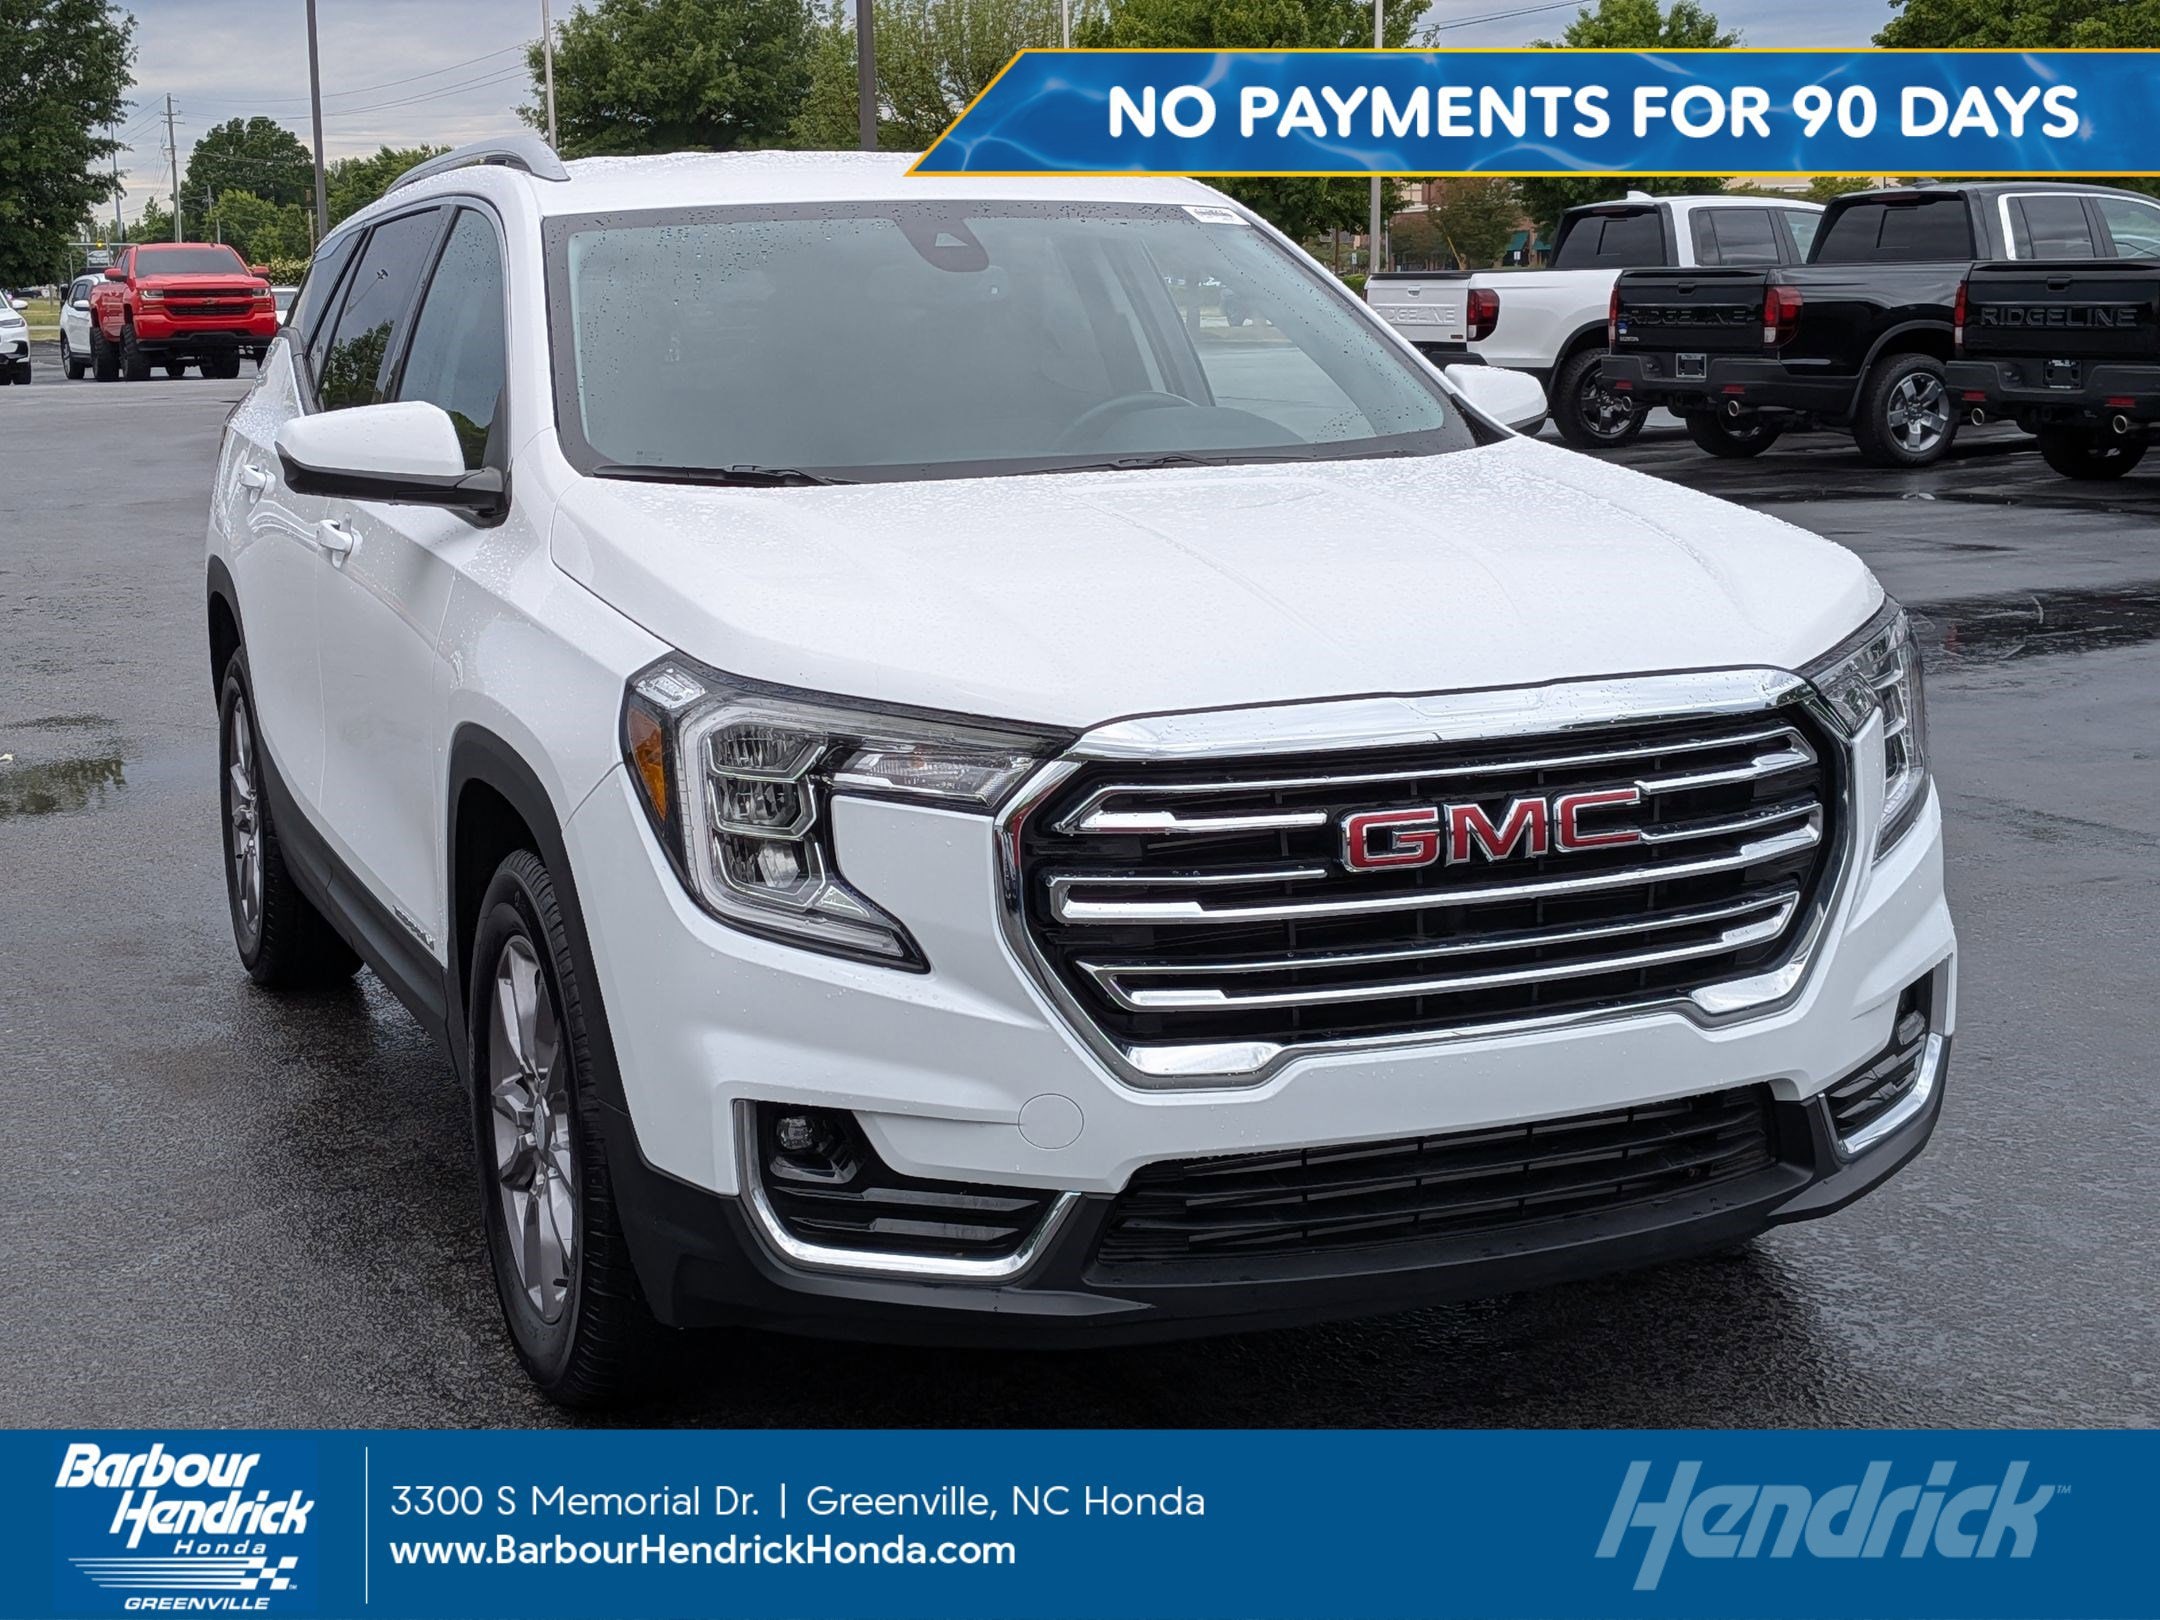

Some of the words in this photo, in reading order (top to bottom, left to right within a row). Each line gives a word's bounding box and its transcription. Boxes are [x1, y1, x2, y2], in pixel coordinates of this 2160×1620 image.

[1629, 309, 1747, 326] RIDGELINE
[1980, 307, 2138, 327] RIDGELINE
[1342, 787, 1642, 873] GMC
